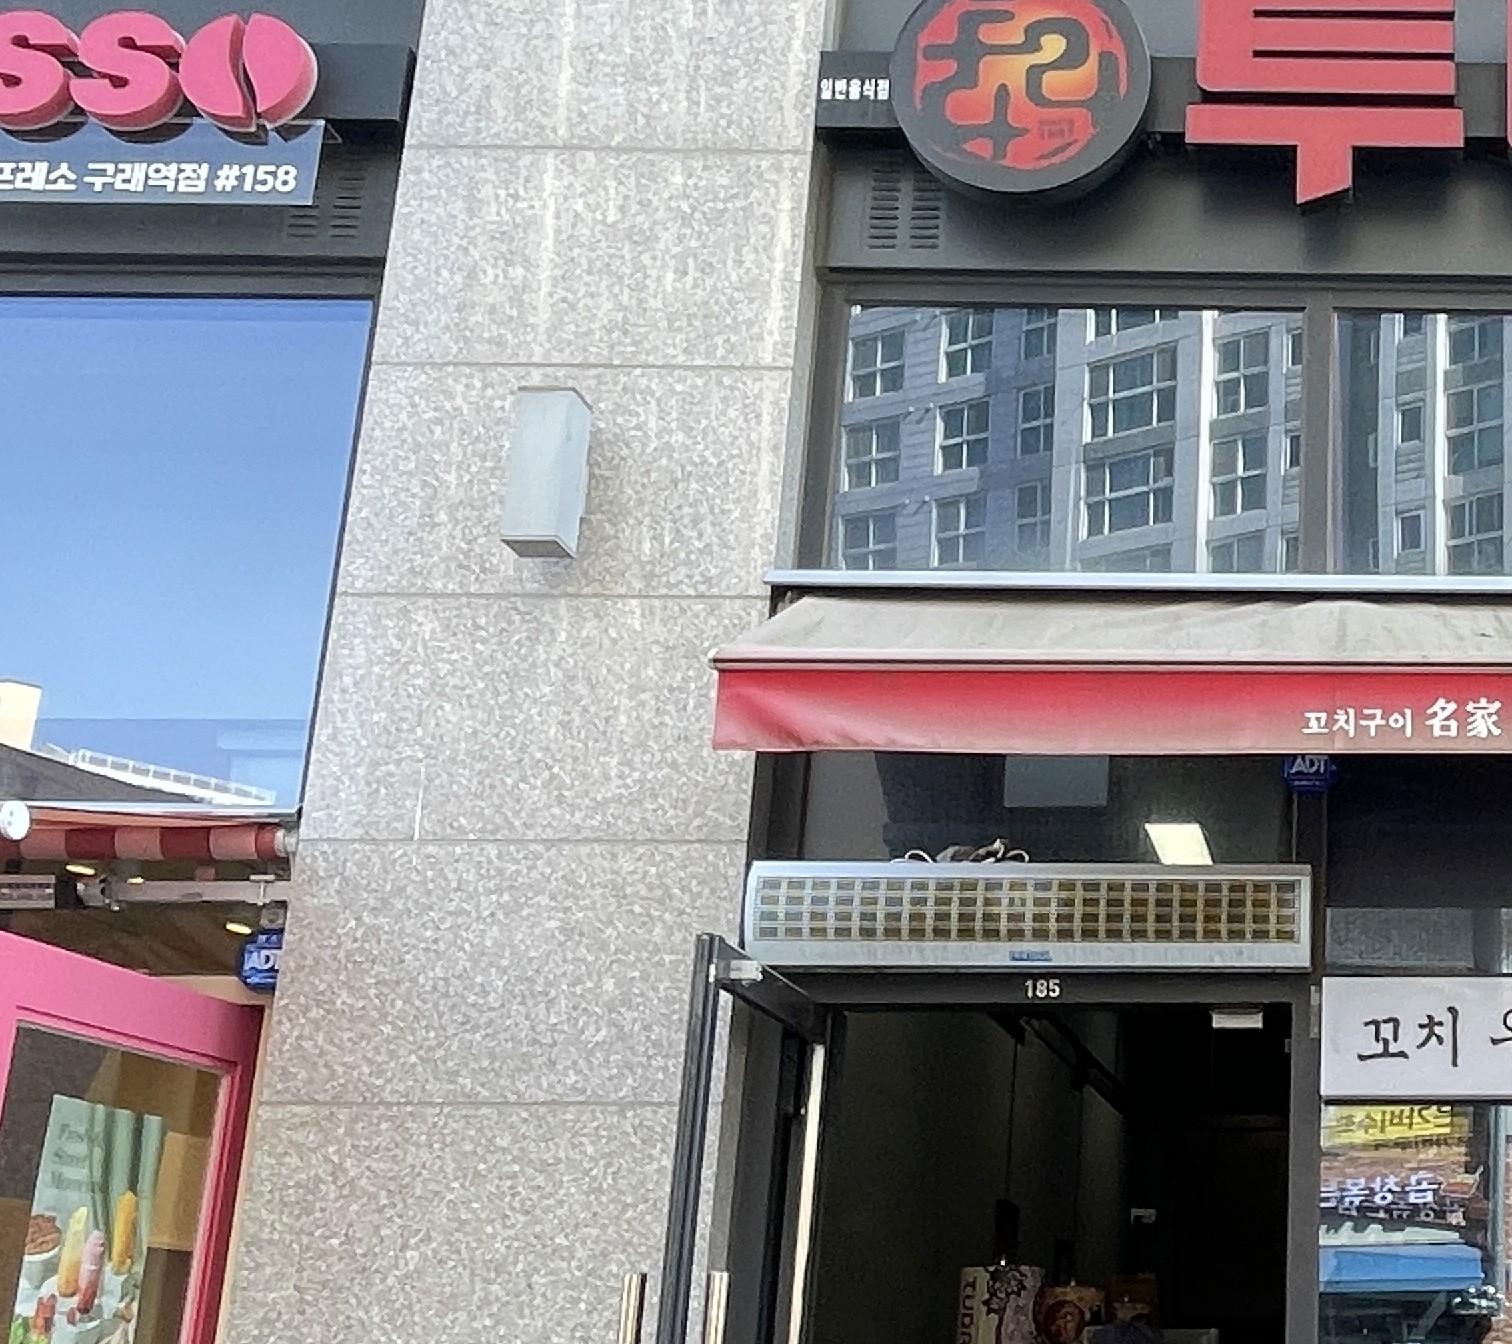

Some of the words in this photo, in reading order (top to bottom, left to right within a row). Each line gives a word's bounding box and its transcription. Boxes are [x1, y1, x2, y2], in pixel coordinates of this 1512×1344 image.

[819, 78, 890, 100] 일반음식점
[83, 160, 208, 194] 구래역점
[213, 163, 298, 193] #158
[1301, 707, 1412, 738] 꼬치구이
[1424, 697, 1502, 738] 名家
[1289, 754, 1329, 774] ADT
[244, 946, 280, 970] AD
[1024, 978, 1061, 999] 185
[1356, 1006, 1461, 1069] 꼬치
